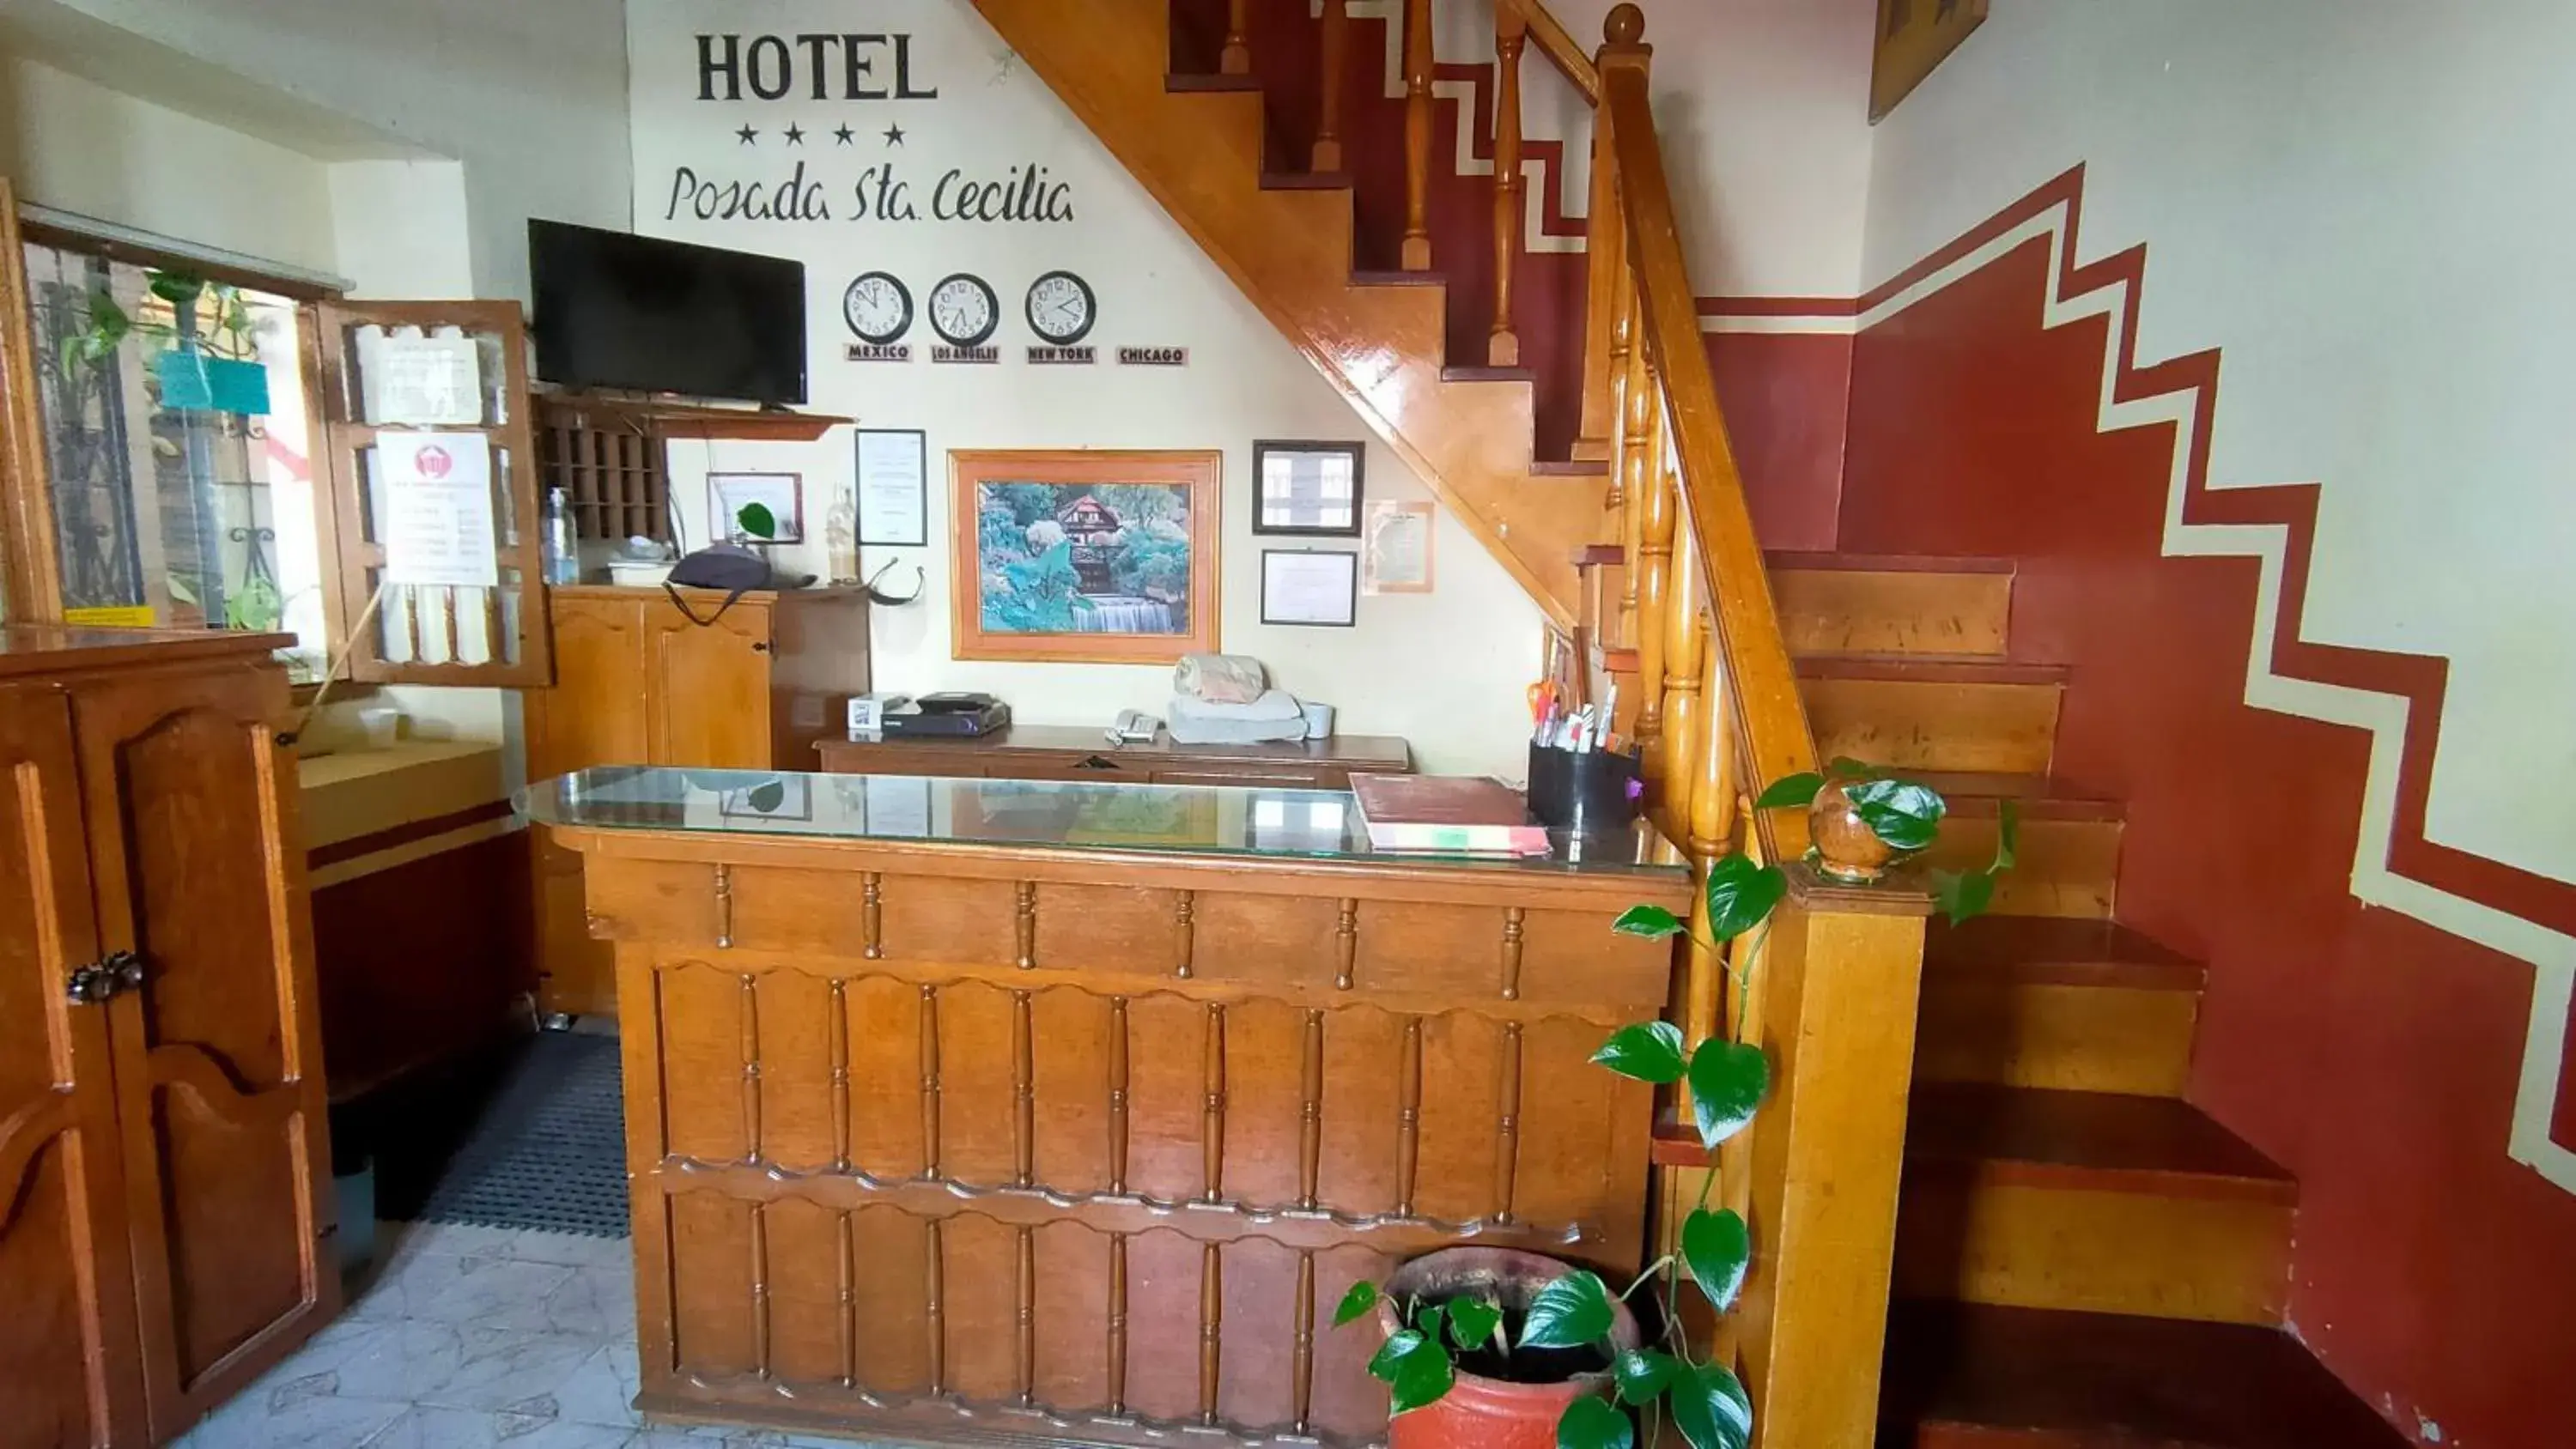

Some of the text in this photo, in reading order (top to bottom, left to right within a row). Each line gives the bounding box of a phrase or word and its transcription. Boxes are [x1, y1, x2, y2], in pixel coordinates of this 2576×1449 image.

[696, 34, 938, 100] HOTEL
[665, 161, 830, 221] Posada
[933, 162, 1073, 222] Cecilia
[848, 345, 908, 357] MEXICO
[933, 347, 998, 359] LOS ANGELES
[1029, 348, 1093, 359] NEW YORK
[1119, 349, 1183, 361] CHICAGO
